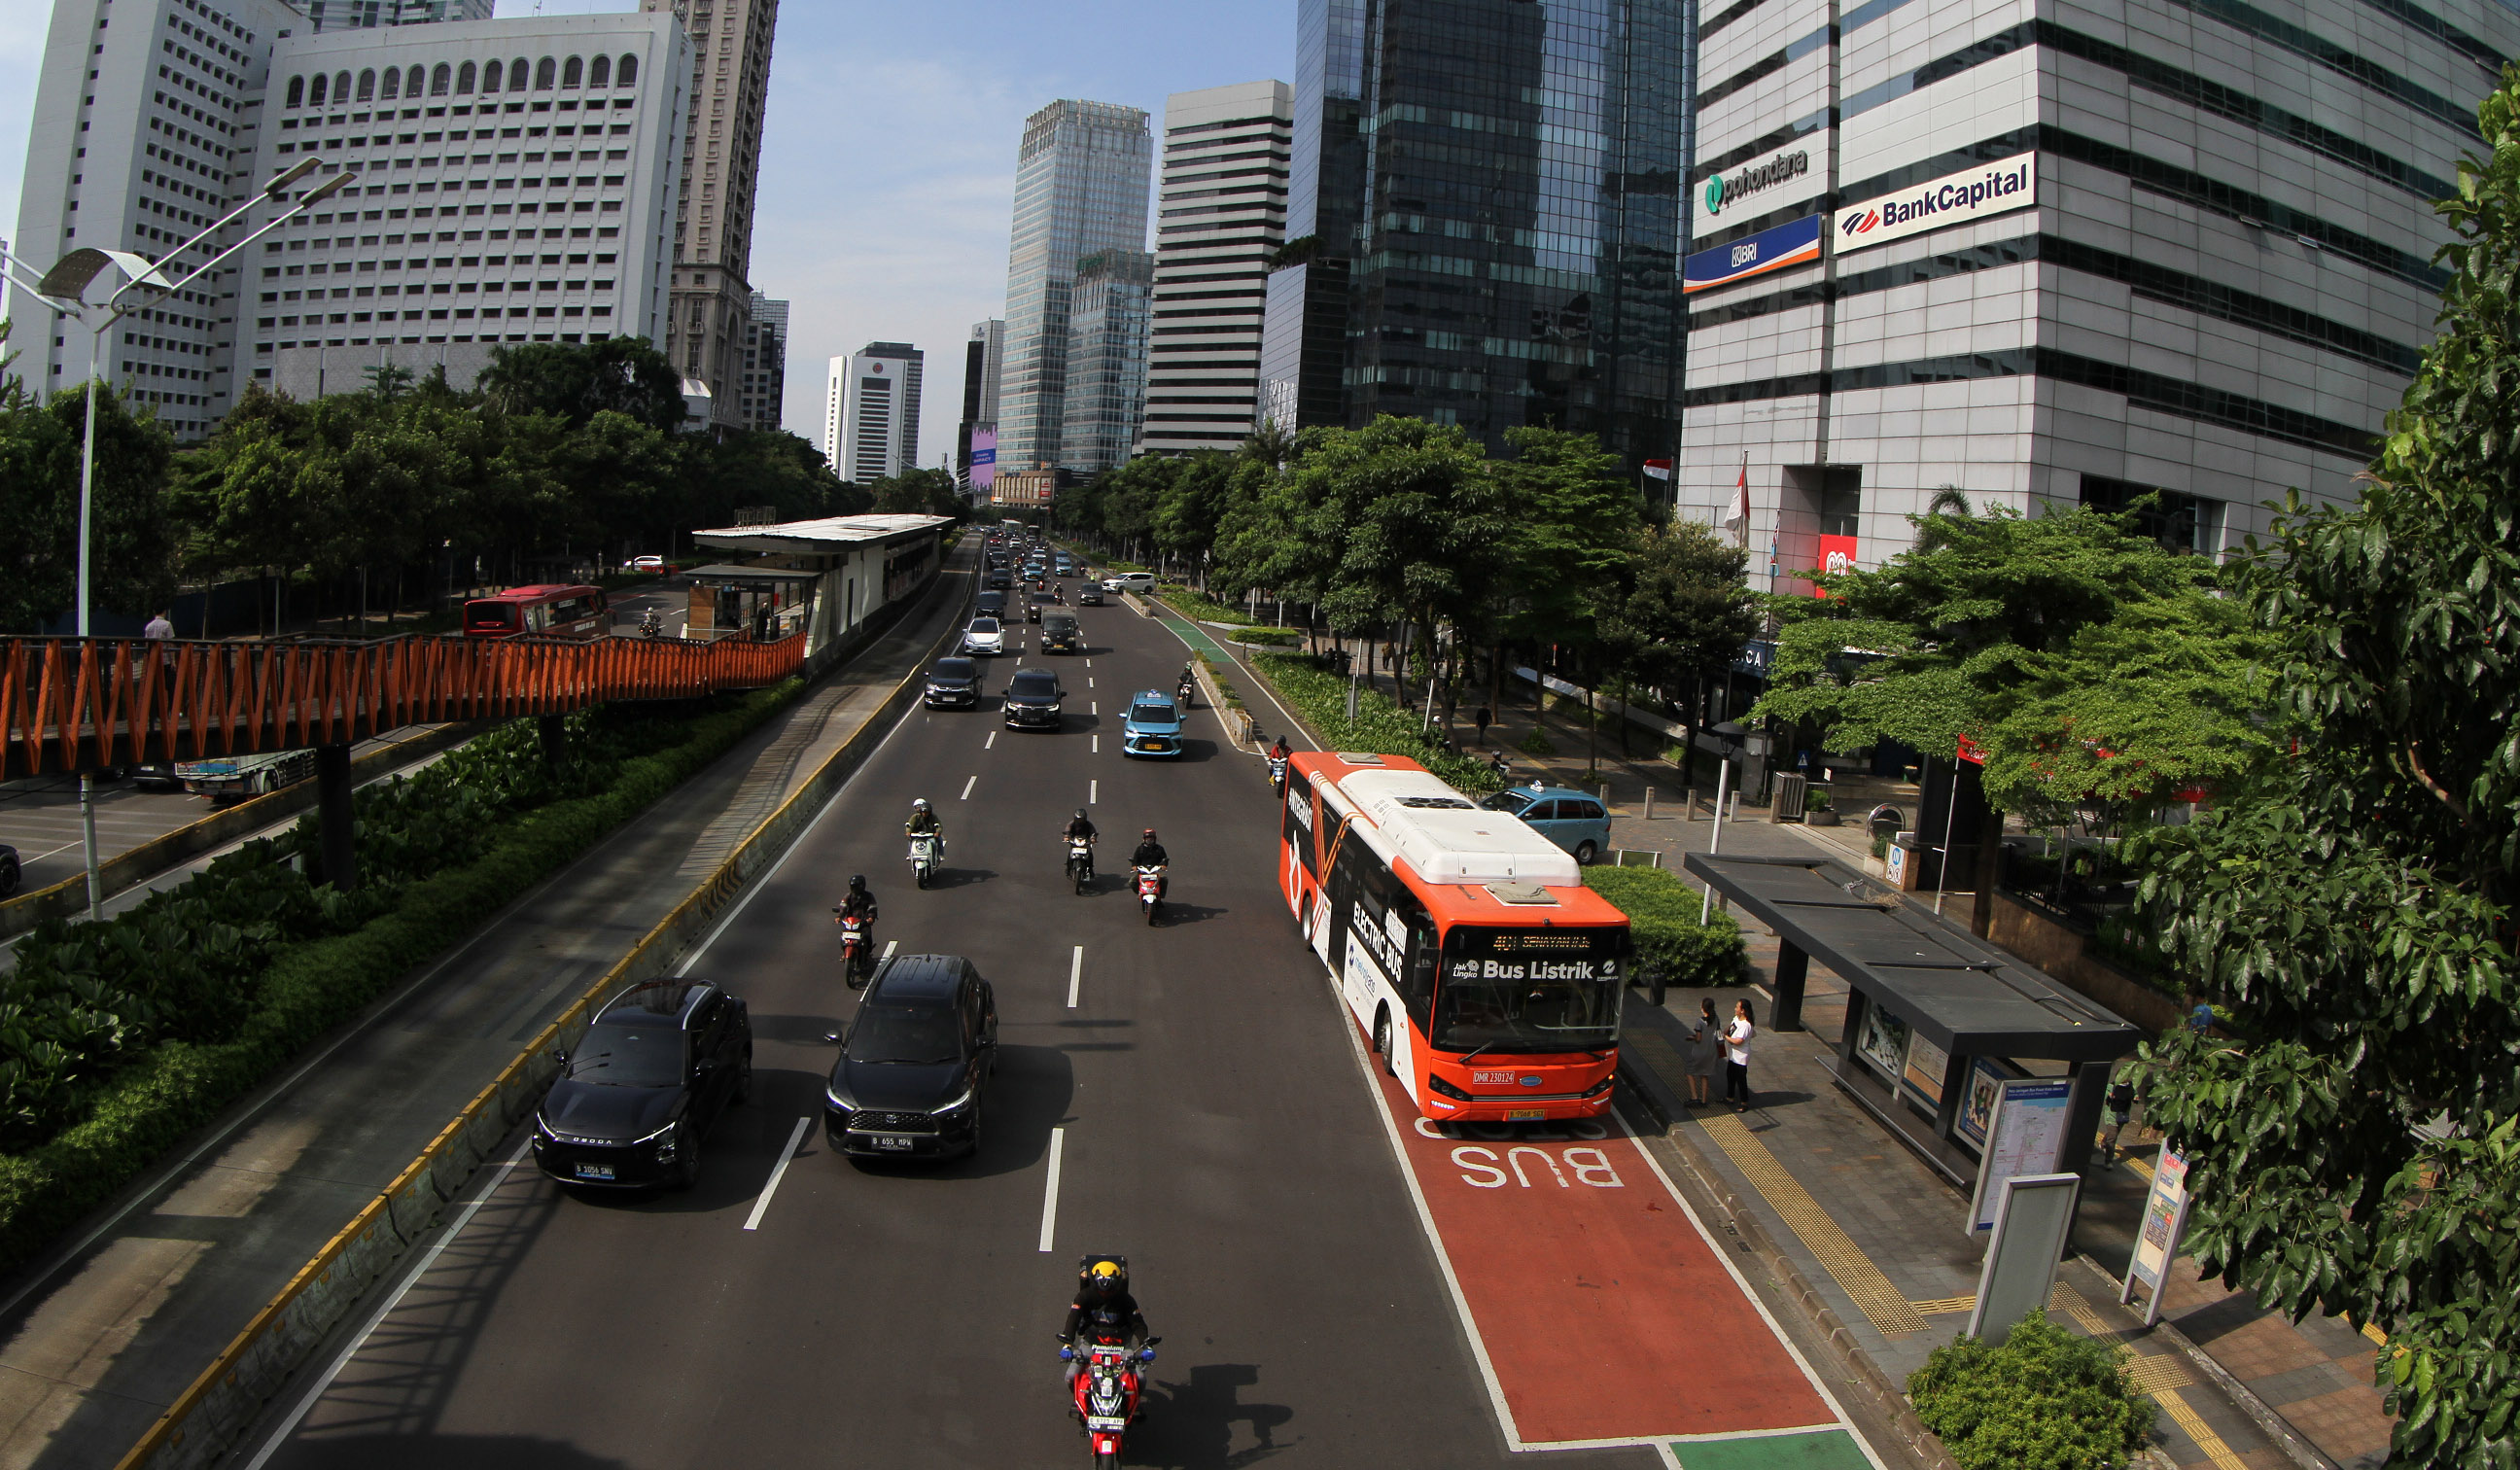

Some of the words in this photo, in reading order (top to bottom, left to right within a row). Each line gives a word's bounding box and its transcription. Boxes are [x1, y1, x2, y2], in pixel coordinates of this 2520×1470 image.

[1723, 149, 1808, 207] pohondana
[1882, 163, 2027, 227] BankCapital
[1740, 242, 1757, 262] BRI
[1352, 900, 1385, 961] ELECTRIC
[1385, 941, 1403, 983] BUS
[1452, 969, 1478, 980] Lingko
[1453, 962, 1467, 971] Jak
[1484, 960, 1524, 979] Bus
[1530, 961, 1594, 980] Listrik
[1474, 1072, 1488, 1083] DMR
[1490, 1071, 1514, 1083] 230124
[1451, 1146, 1625, 1188] BUS
